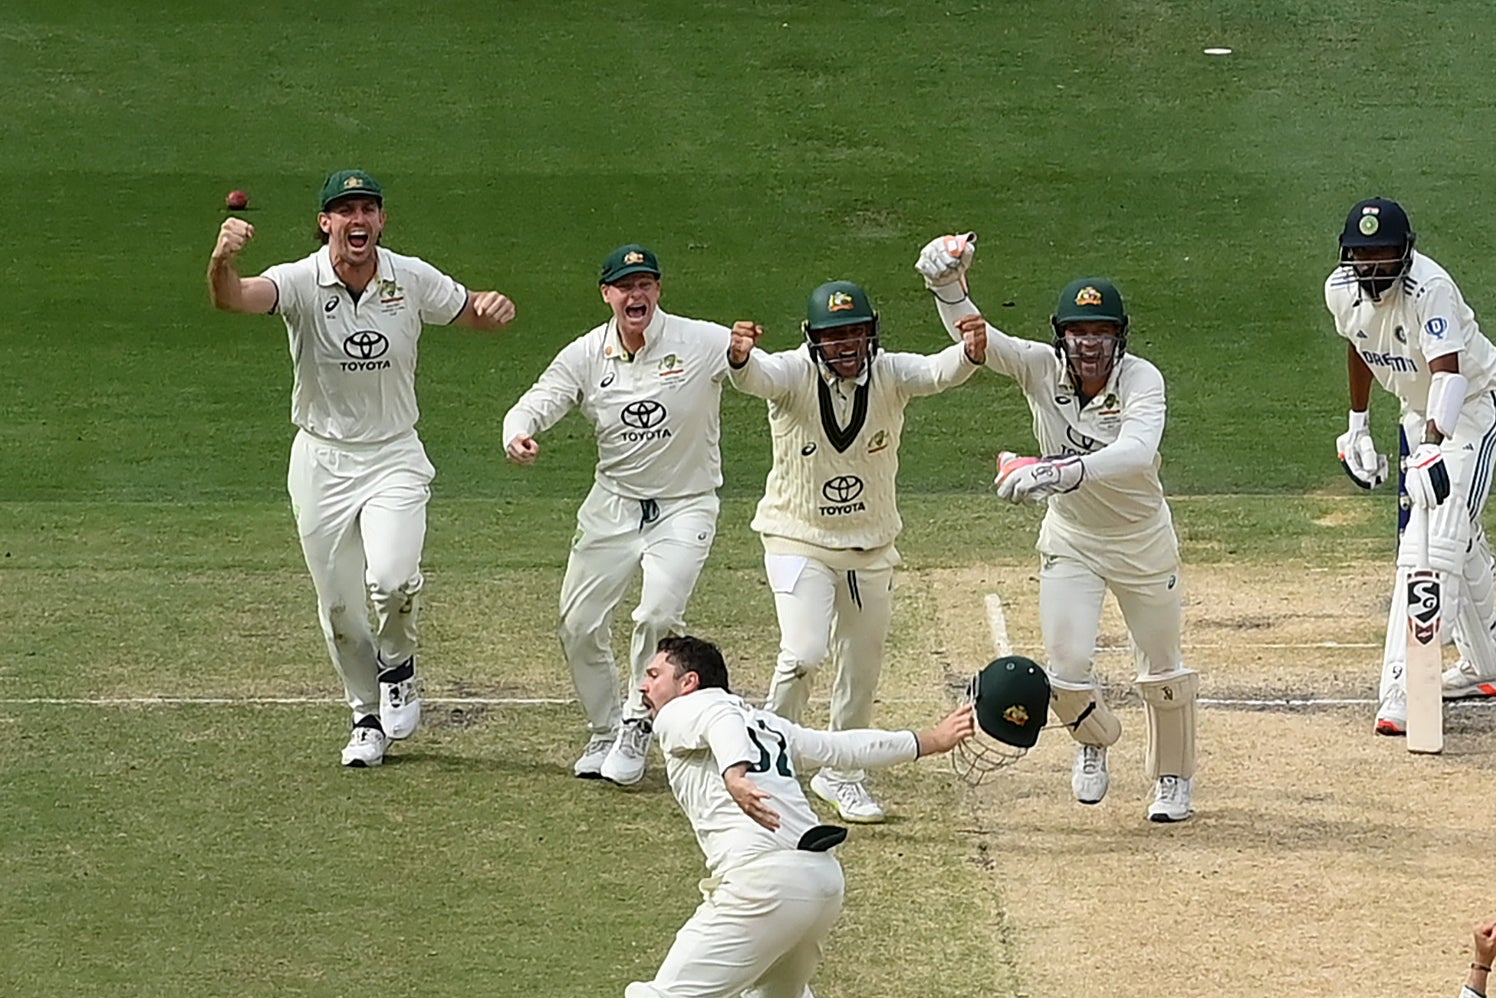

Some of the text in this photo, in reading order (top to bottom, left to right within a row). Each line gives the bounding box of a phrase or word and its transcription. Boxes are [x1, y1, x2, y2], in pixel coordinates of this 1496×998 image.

[340, 361, 391, 372] TOYOTA
[621, 429, 671, 442] TOYOTA
[819, 502, 866, 516] TOYOTA
